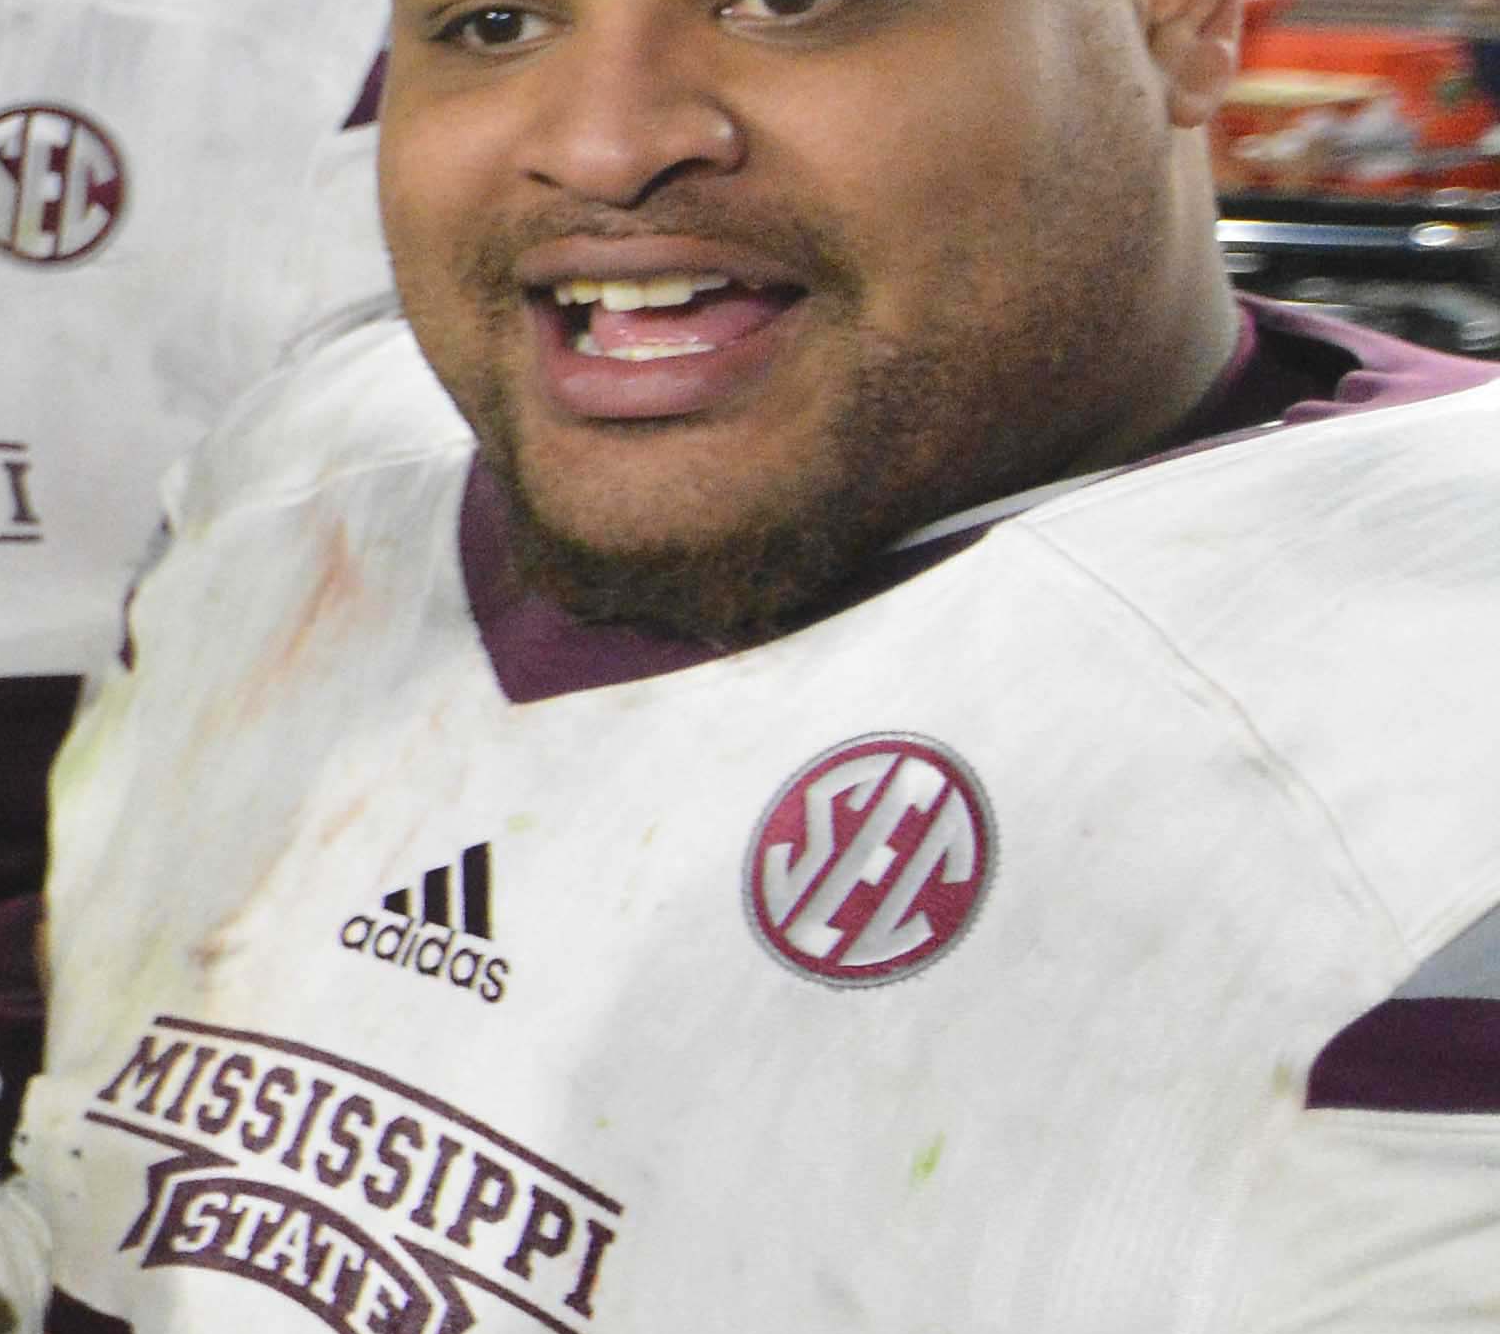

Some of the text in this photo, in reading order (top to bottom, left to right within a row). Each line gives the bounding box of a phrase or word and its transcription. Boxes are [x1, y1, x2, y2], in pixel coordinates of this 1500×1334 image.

[338, 908, 512, 1004] adidas
[759, 747, 978, 965] SEC
[96, 1033, 624, 1321] MISSISSIPPI
